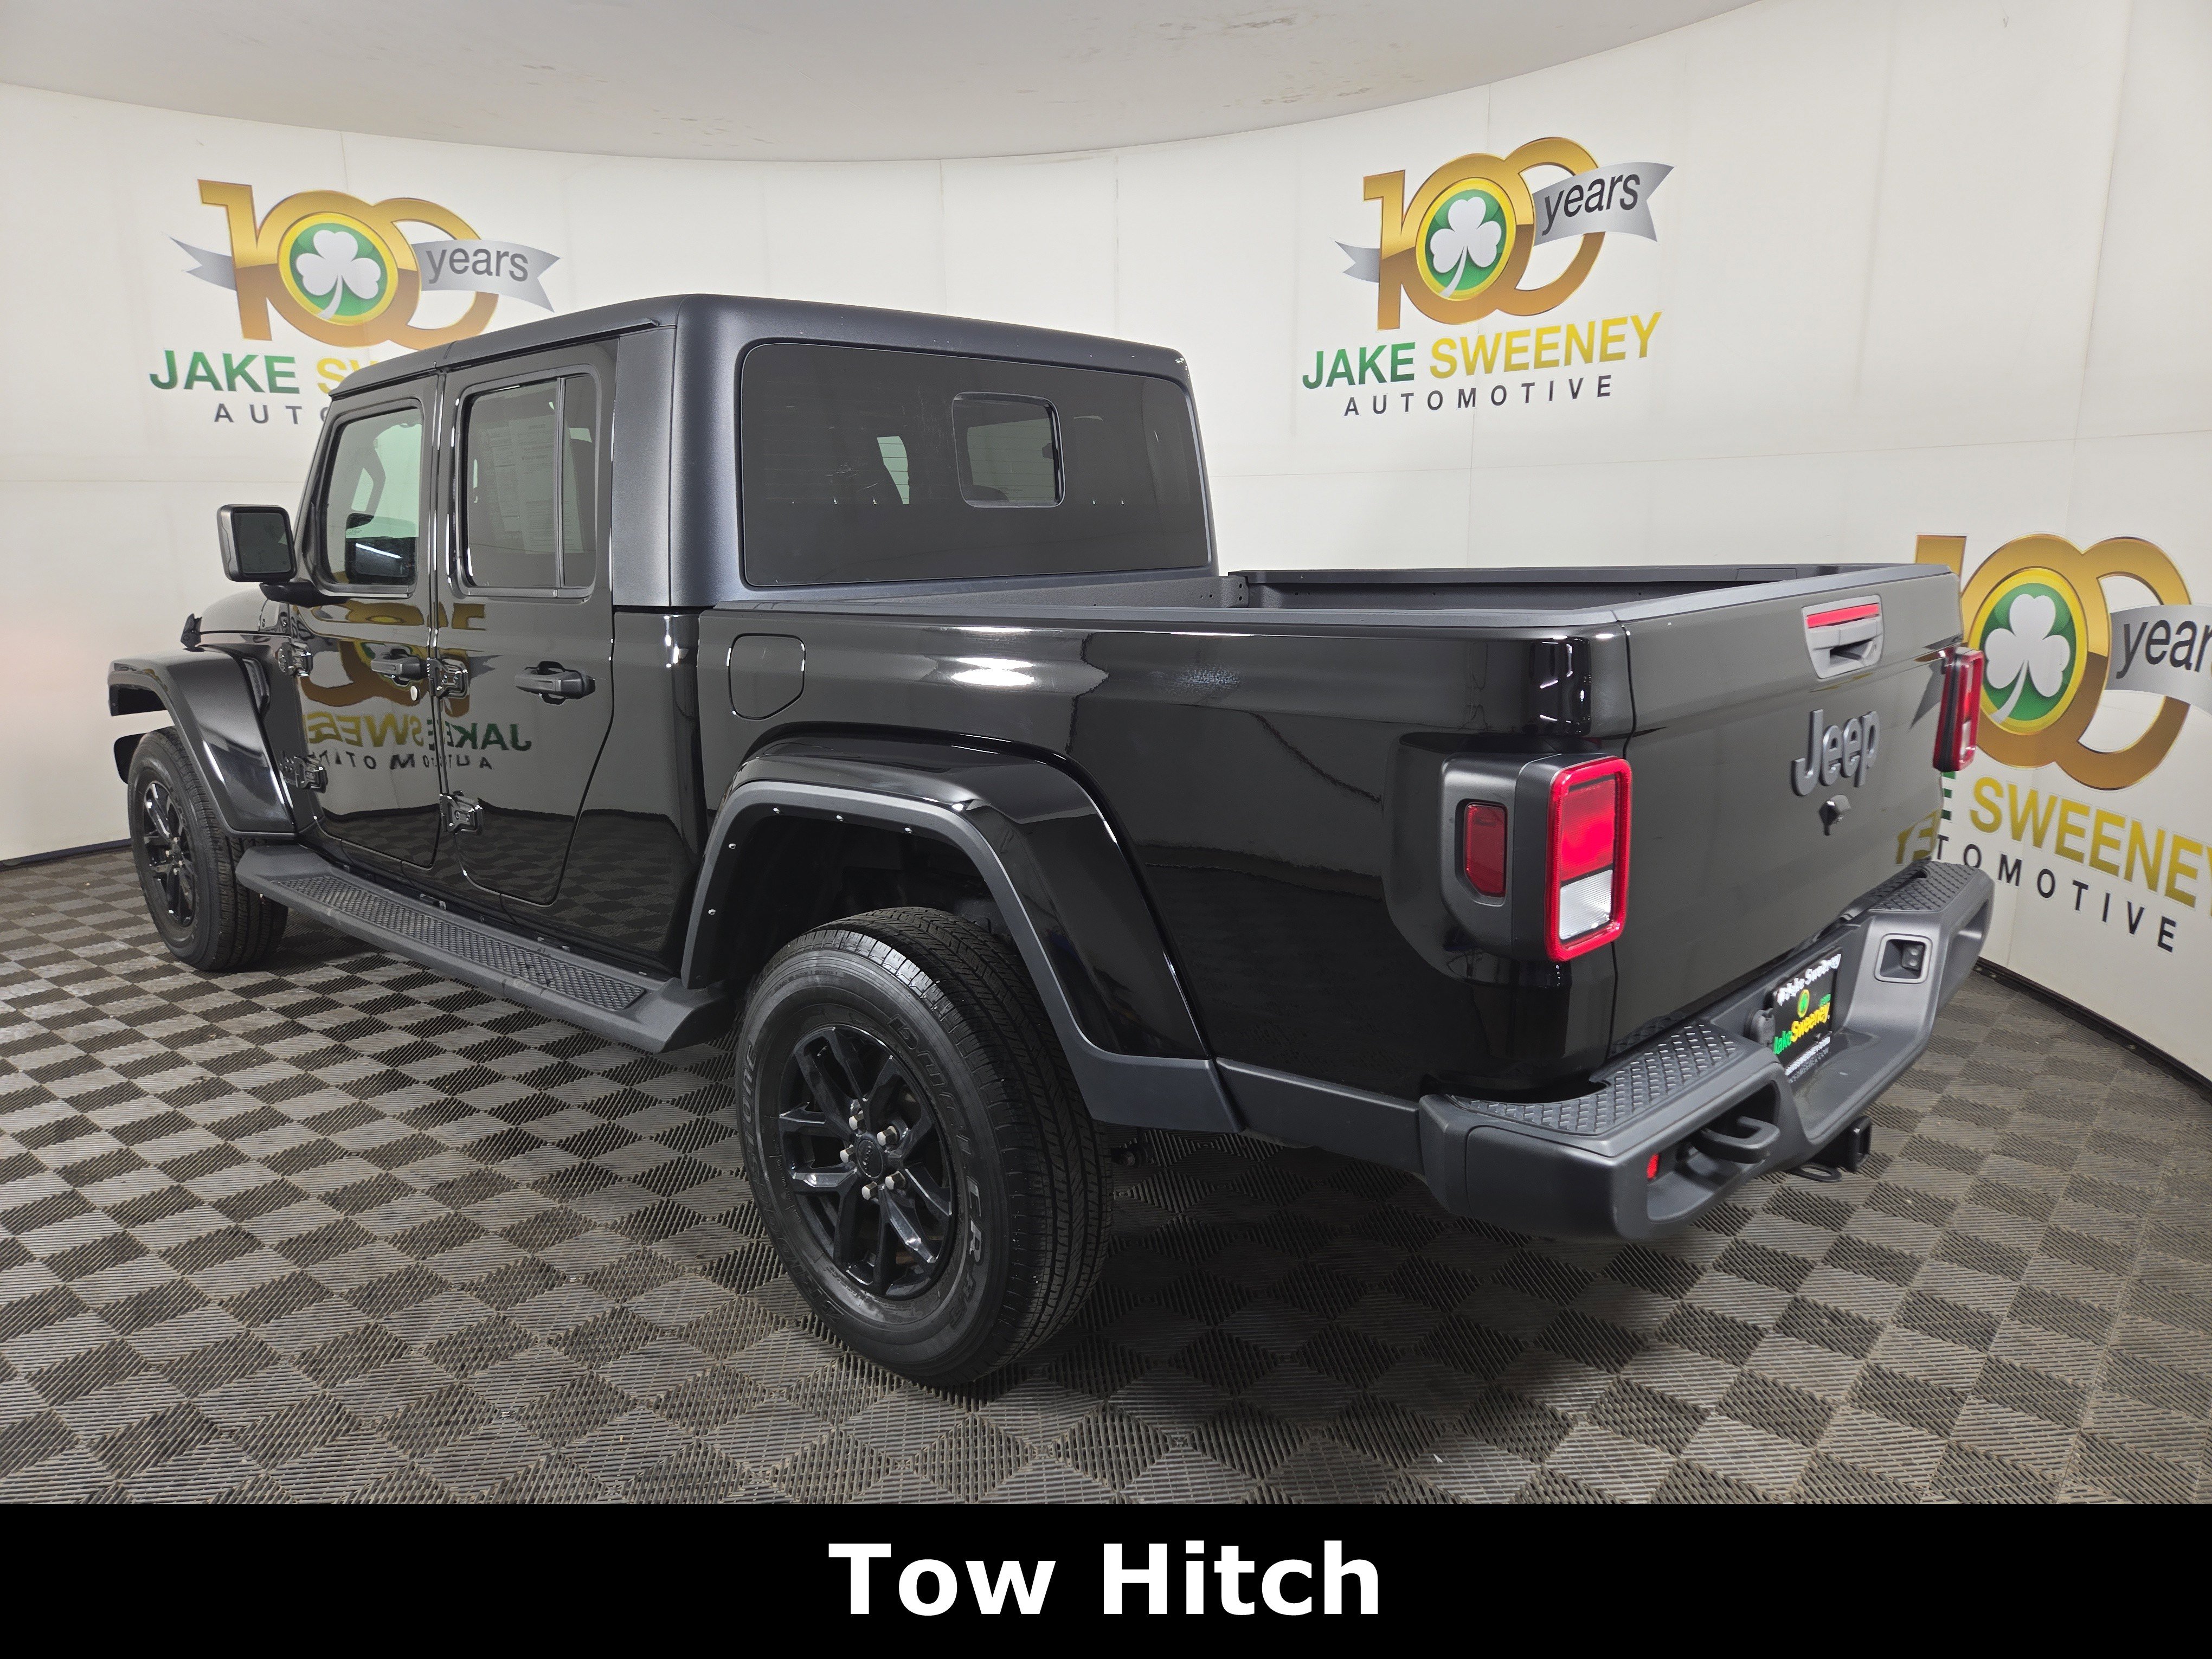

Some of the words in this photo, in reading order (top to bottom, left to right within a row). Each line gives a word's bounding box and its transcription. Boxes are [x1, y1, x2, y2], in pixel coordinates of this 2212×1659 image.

[1541, 173, 1641, 236] years
[426, 247, 529, 283] years
[149, 350, 300, 394] JAKE
[1302, 342, 1416, 389] JAKE
[1430, 311, 1663, 380] SWEENEY
[1343, 375, 1612, 416] AUTOMOTIVE
[2115, 619, 2212, 679] year
[1791, 709, 1880, 796] Jeep
[1970, 776, 2212, 917] SWEENE
[1937, 834, 2177, 953] TOMOTIVE
